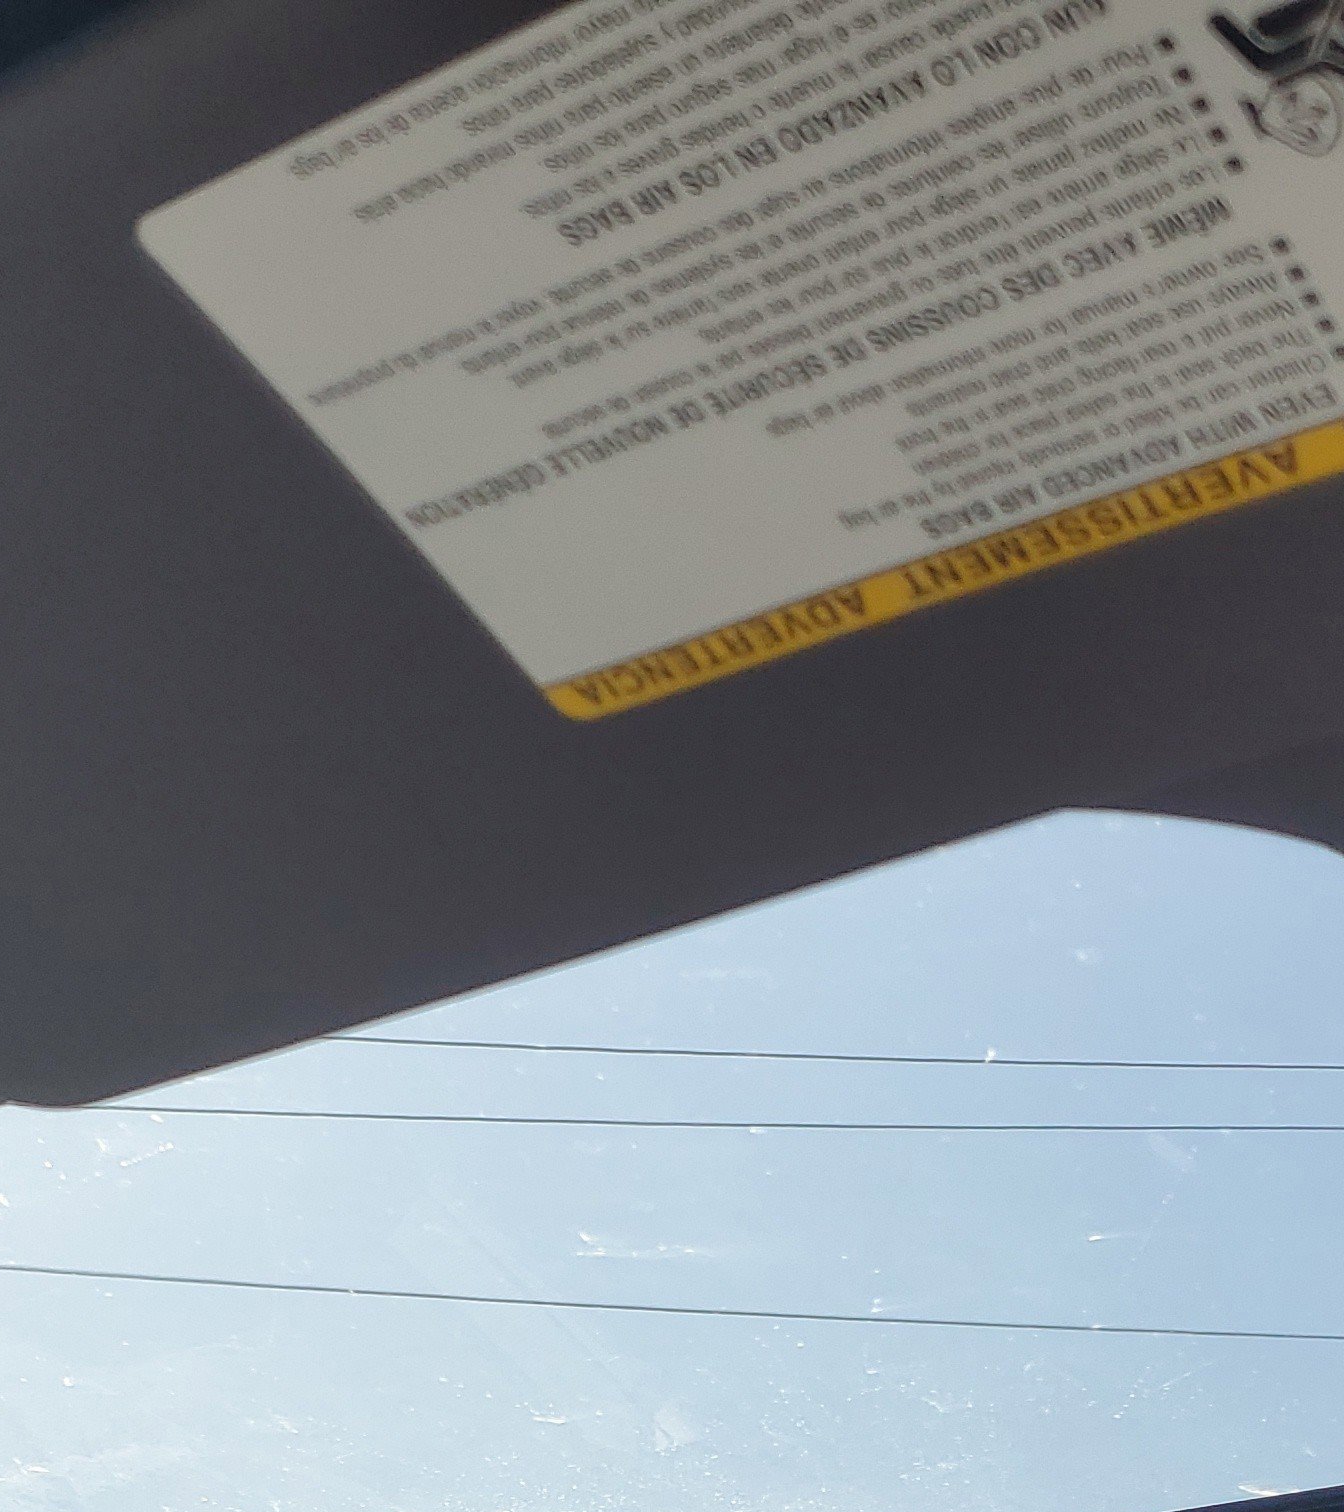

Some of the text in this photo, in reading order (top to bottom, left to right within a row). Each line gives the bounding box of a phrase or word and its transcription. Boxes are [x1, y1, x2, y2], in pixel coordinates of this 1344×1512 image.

[778, 33, 830, 69] lugar
[858, 31, 926, 69] causar
[973, 22, 1044, 69] CON
[1103, 46, 1148, 76] Pour
[506, 79, 552, 110] para
[665, 76, 732, 116] seguro
[768, 71, 837, 113] muerte
[1020, 78, 1064, 110] plus
[1076, 73, 1166, 124] Toujours
[560, 94, 605, 125] para
[621, 106, 666, 136] para
[774, 72, 930, 154] AVANZADO
[357, 126, 387, 149] los
[594, 129, 625, 154] los
[1010, 114, 1075, 152] utiliser
[1079, 121, 1150, 161] mettez
[333, 140, 359, 161] air
[614, 137, 678, 175] graves
[979, 141, 1008, 165] les
[677, 155, 737, 195] LOS
[1010, 146, 1078, 188] jamais
[1179, 166, 1217, 193] Les
[571, 175, 603, 199] los
[629, 180, 680, 216] AIR
[1100, 182, 1176, 223] enfants
[556, 200, 633, 247] BAGS
[719, 211, 755, 236] des
[881, 207, 925, 236] pour
[1010, 198, 1044, 224] est
[1142, 198, 1233, 250] MÊME
[821, 229, 882, 265] enfant
[1018, 209, 1099, 254] peuvent
[734, 242, 764, 264] les
[868, 247, 912, 278] plus
[1061, 232, 1142, 281] AVEC
[1220, 244, 1263, 273] See
[716, 279, 755, 303] vers
[792, 277, 836, 304] pour
[1000, 263, 1062, 304] DES
[767, 297, 794, 318] les
[811, 283, 909, 333] gravement
[864, 286, 1003, 355] COUSSINS
[1069, 290, 1140, 328] manual
[1236, 299, 1295, 332] Never
[519, 322, 559, 347] pour
[623, 322, 650, 340] sur
[988, 268, 1279, 389] Always use seat belts and child
[991, 328, 1035, 353] more
[1039, 317, 1066, 339] for
[1196, 319, 1232, 345] put
[1271, 328, 1309, 353] The
[713, 348, 742, 368] par
[1221, 342, 1268, 370] back
[703, 353, 828, 416] SÉCURITÉ
[1175, 360, 1218, 386] seat
[1248, 353, 1325, 392] Children
[834, 384, 887, 414] about
[1033, 377, 1077, 403] child
[1123, 383, 1152, 404] the
[1205, 382, 1239, 403] can
[811, 403, 836, 422] air
[991, 394, 1030, 418] seat
[1064, 394, 1120, 425] safest
[1123, 406, 1175, 435] killed
[939, 416, 968, 437] the
[1010, 412, 1061, 442] place
[543, 414, 670, 476] NOUVELLE
[984, 433, 1009, 452] for
[1017, 428, 1100, 470] seriously
[918, 384, 1335, 539] EVEN WITH ADVANCED AIR BAGS
[953, 457, 1018, 492] injured
[402, 461, 548, 529] GÉNÉRATION
[878, 500, 902, 519] air
[901, 490, 931, 511] the
[898, 443, 1308, 599] AVERTISSEMENT
[569, 588, 875, 706] ADVERTENCIA
